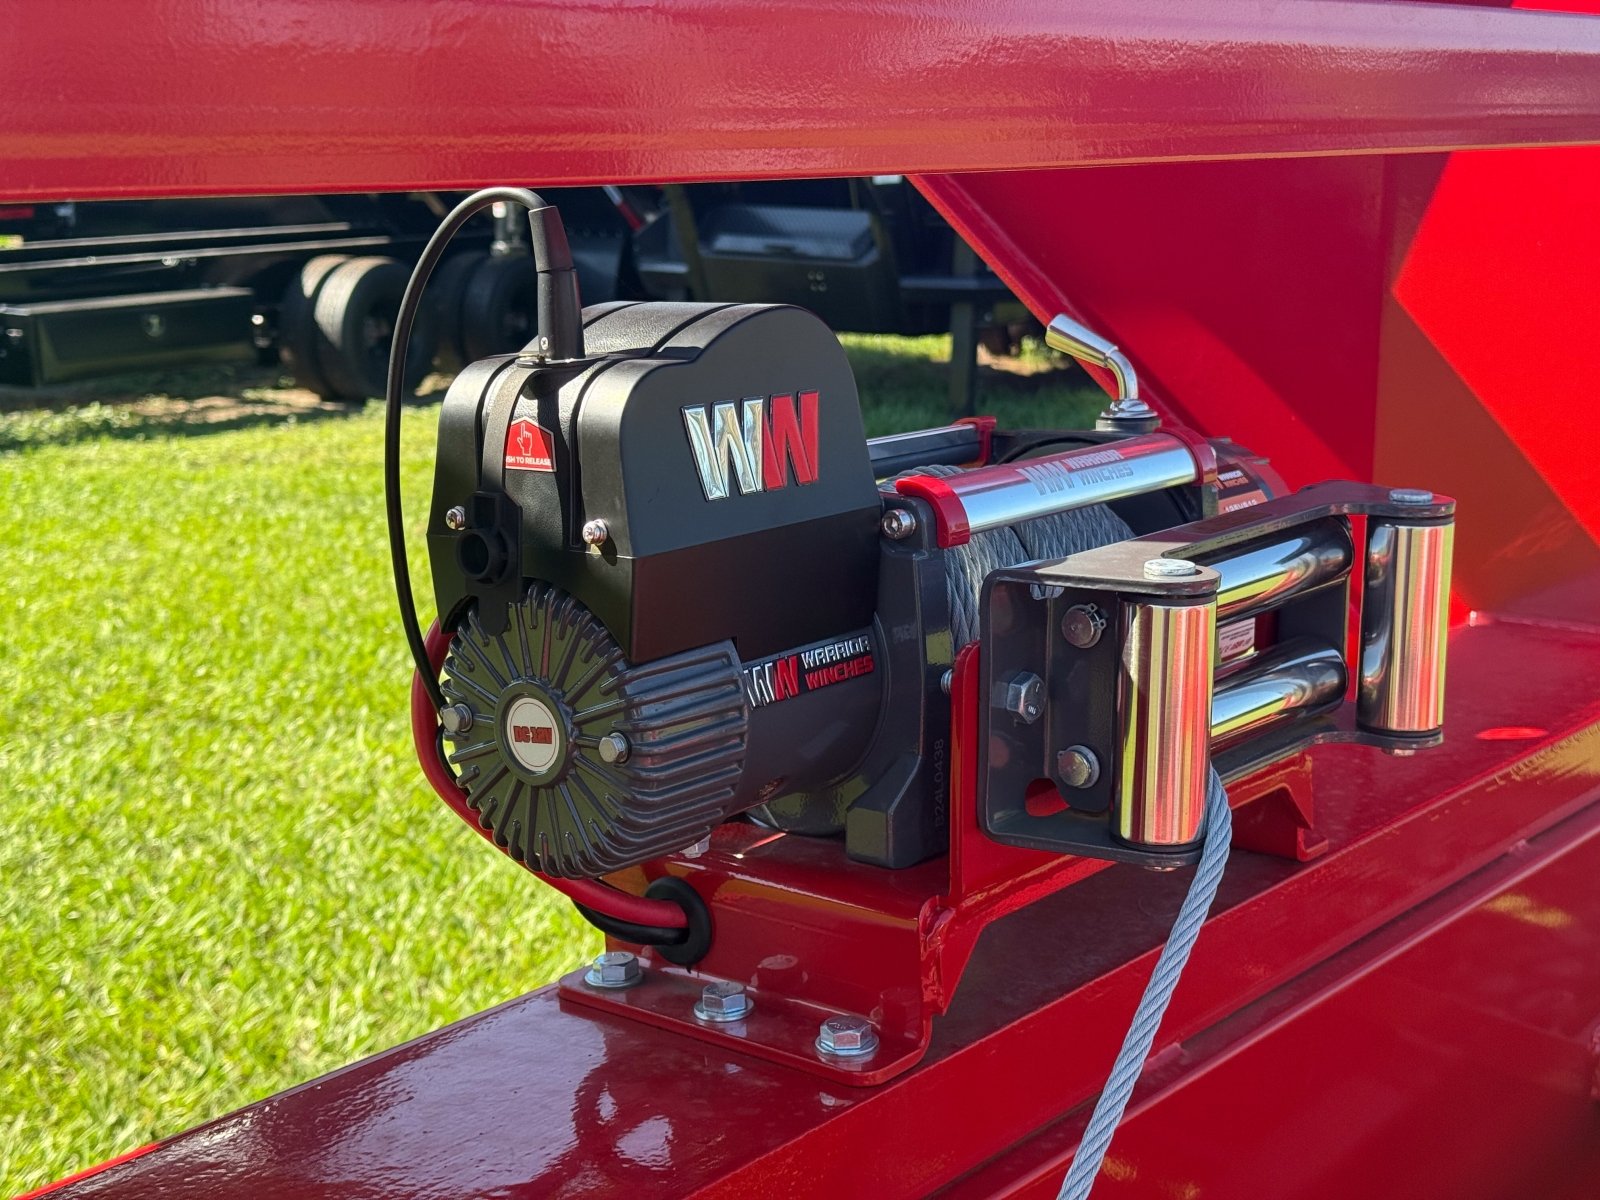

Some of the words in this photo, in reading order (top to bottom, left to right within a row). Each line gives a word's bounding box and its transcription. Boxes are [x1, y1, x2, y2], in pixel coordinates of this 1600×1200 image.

[515, 456, 525, 464] TO
[525, 456, 552, 467] RELEASE
[1061, 449, 1124, 470] WARRIOR
[1077, 463, 1134, 486] WINCHES
[800, 635, 871, 669] WARRIOR
[804, 655, 875, 691] WINCHES
[513, 725, 530, 743] DC
